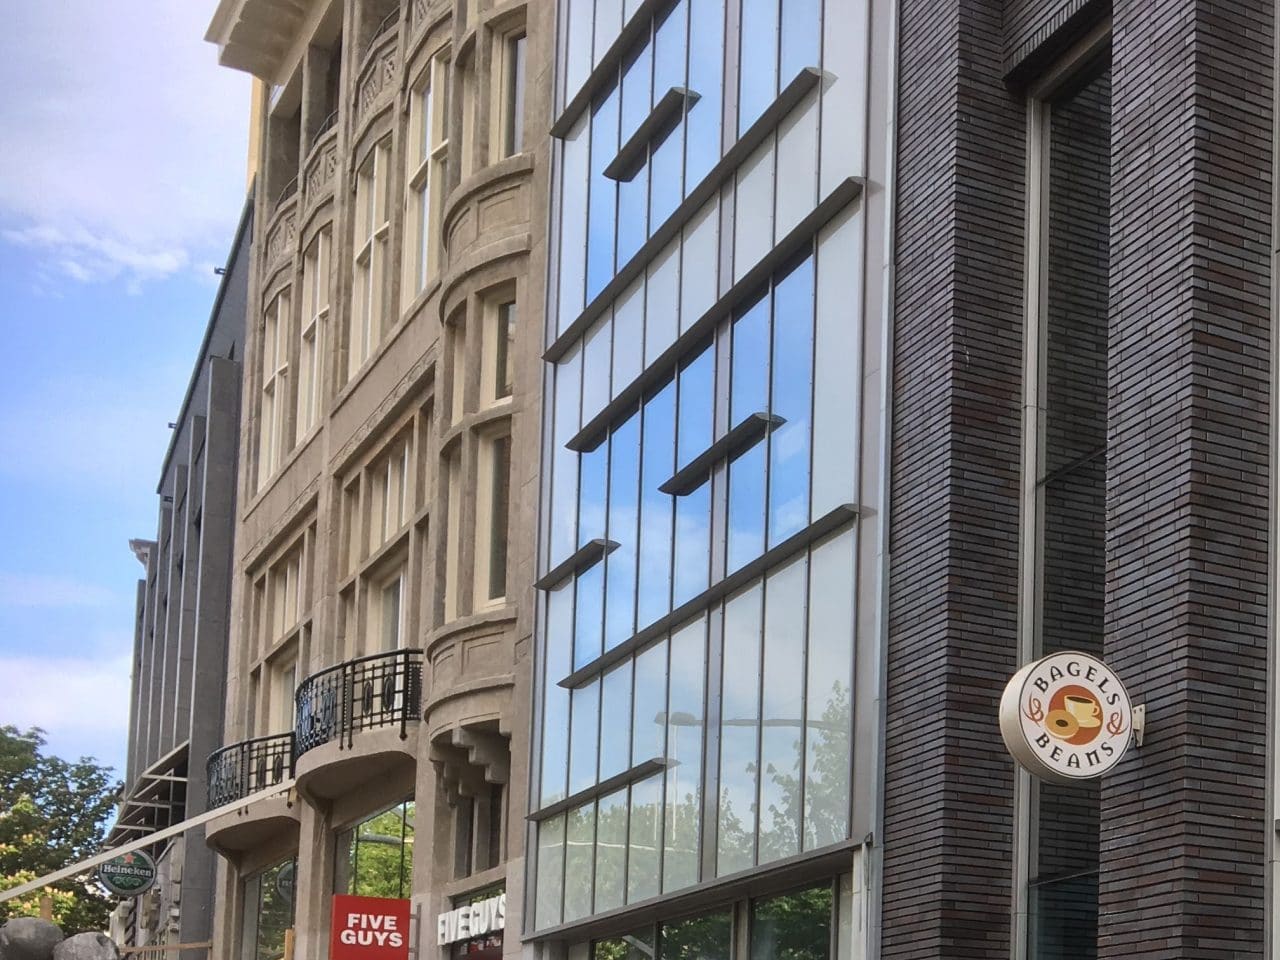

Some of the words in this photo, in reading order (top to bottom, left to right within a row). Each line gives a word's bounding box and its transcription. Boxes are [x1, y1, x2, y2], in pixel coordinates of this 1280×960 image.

[1033, 661, 1121, 706] BAGELS
[1035, 733, 1114, 769] BEANS
[103, 863, 152, 877] Heineken
[347, 913, 397, 930] FIVE
[437, 905, 471, 946] FIVE
[340, 930, 403, 948] GUYS
